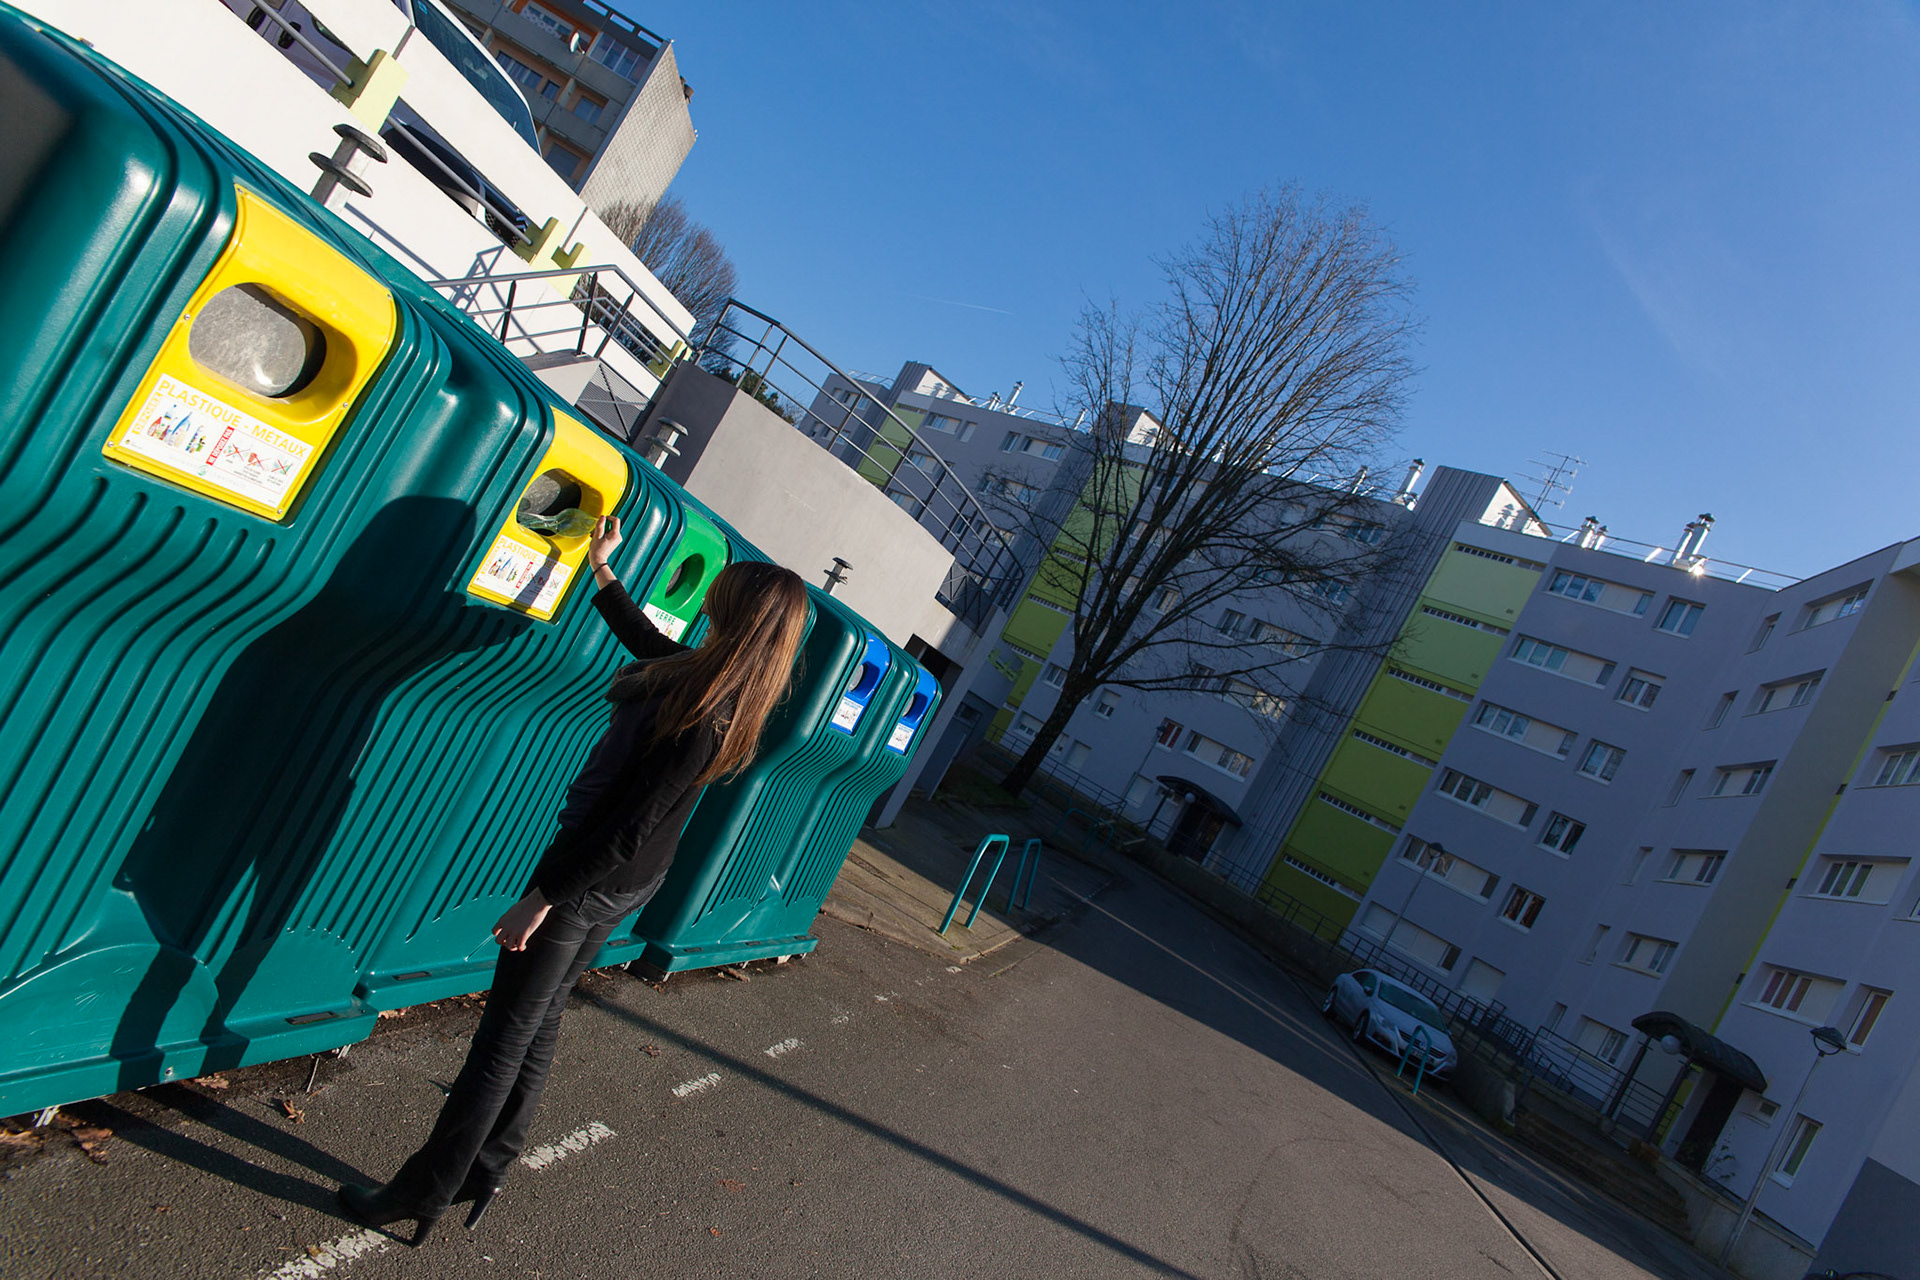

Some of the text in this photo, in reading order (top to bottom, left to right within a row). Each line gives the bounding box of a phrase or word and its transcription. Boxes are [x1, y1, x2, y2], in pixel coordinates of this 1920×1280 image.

[158, 380, 242, 427] PLASTIQUE
[251, 424, 307, 457] MÉTAUX
[498, 538, 537, 562] PLASTIQUE
[655, 609, 676, 625] VERRE
